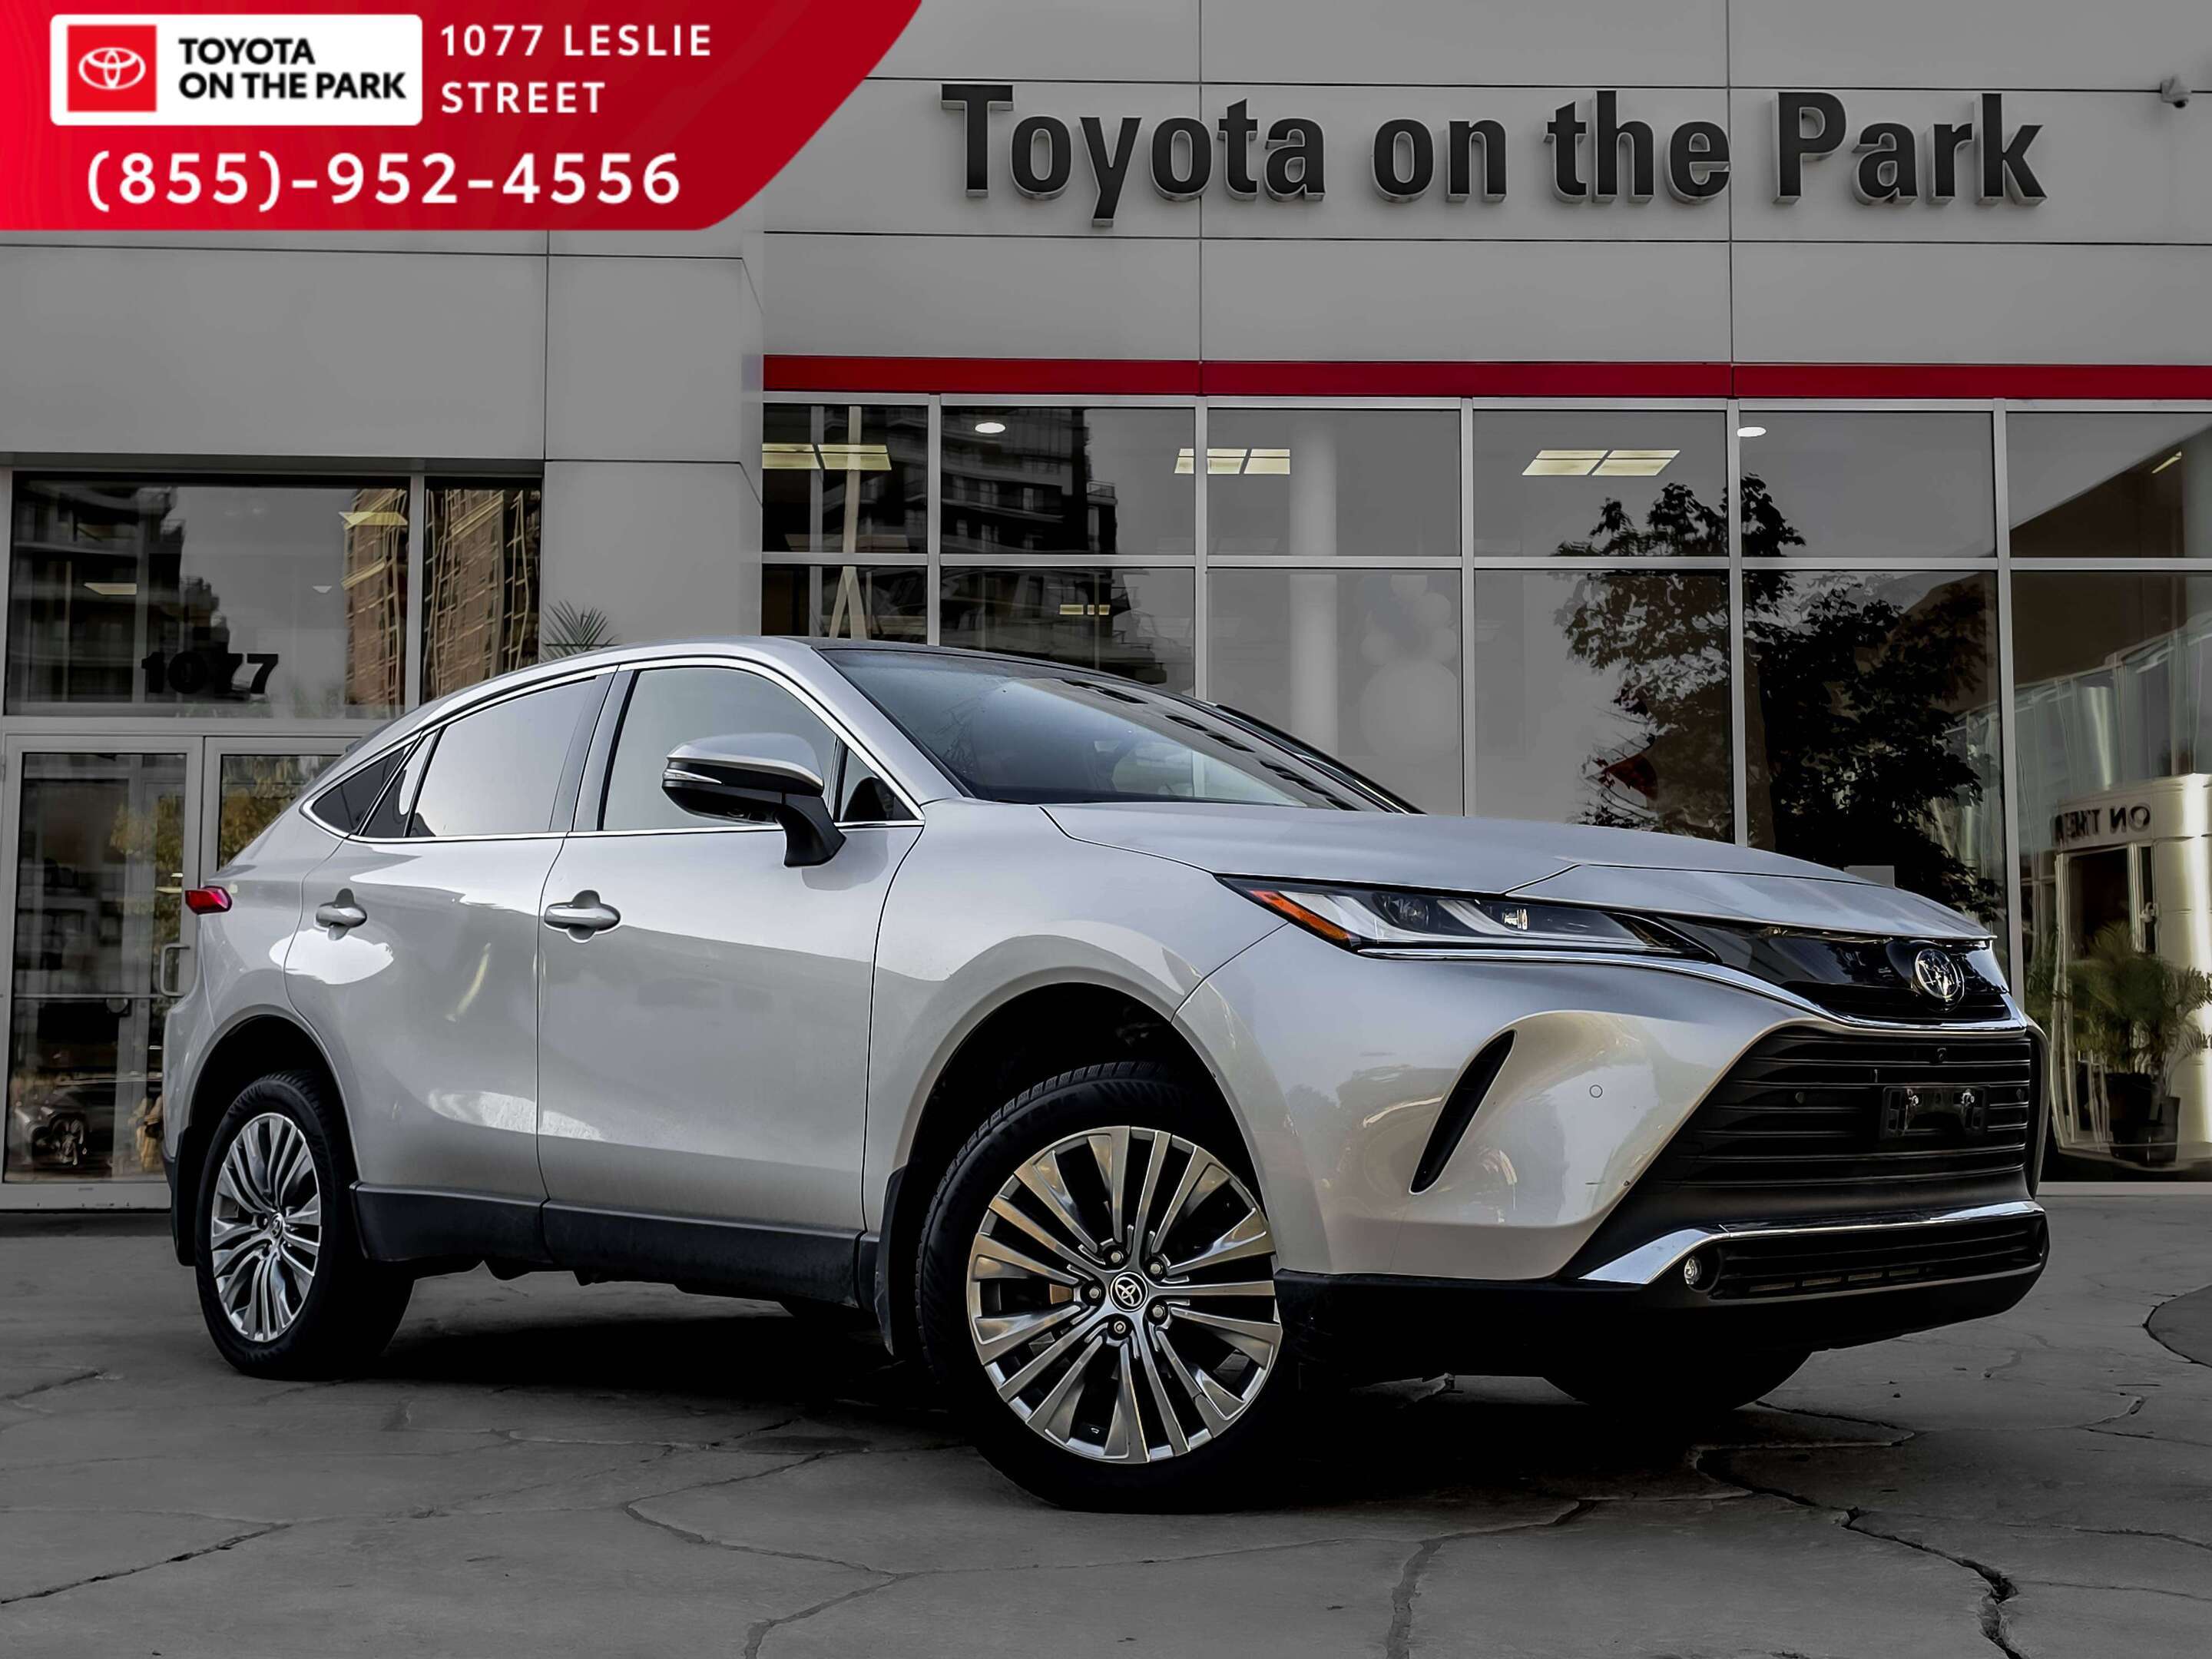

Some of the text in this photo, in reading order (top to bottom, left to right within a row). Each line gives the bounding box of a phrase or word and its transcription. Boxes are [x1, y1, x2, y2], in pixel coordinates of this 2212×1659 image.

[942, 84, 2048, 228] Toyota on the Park
